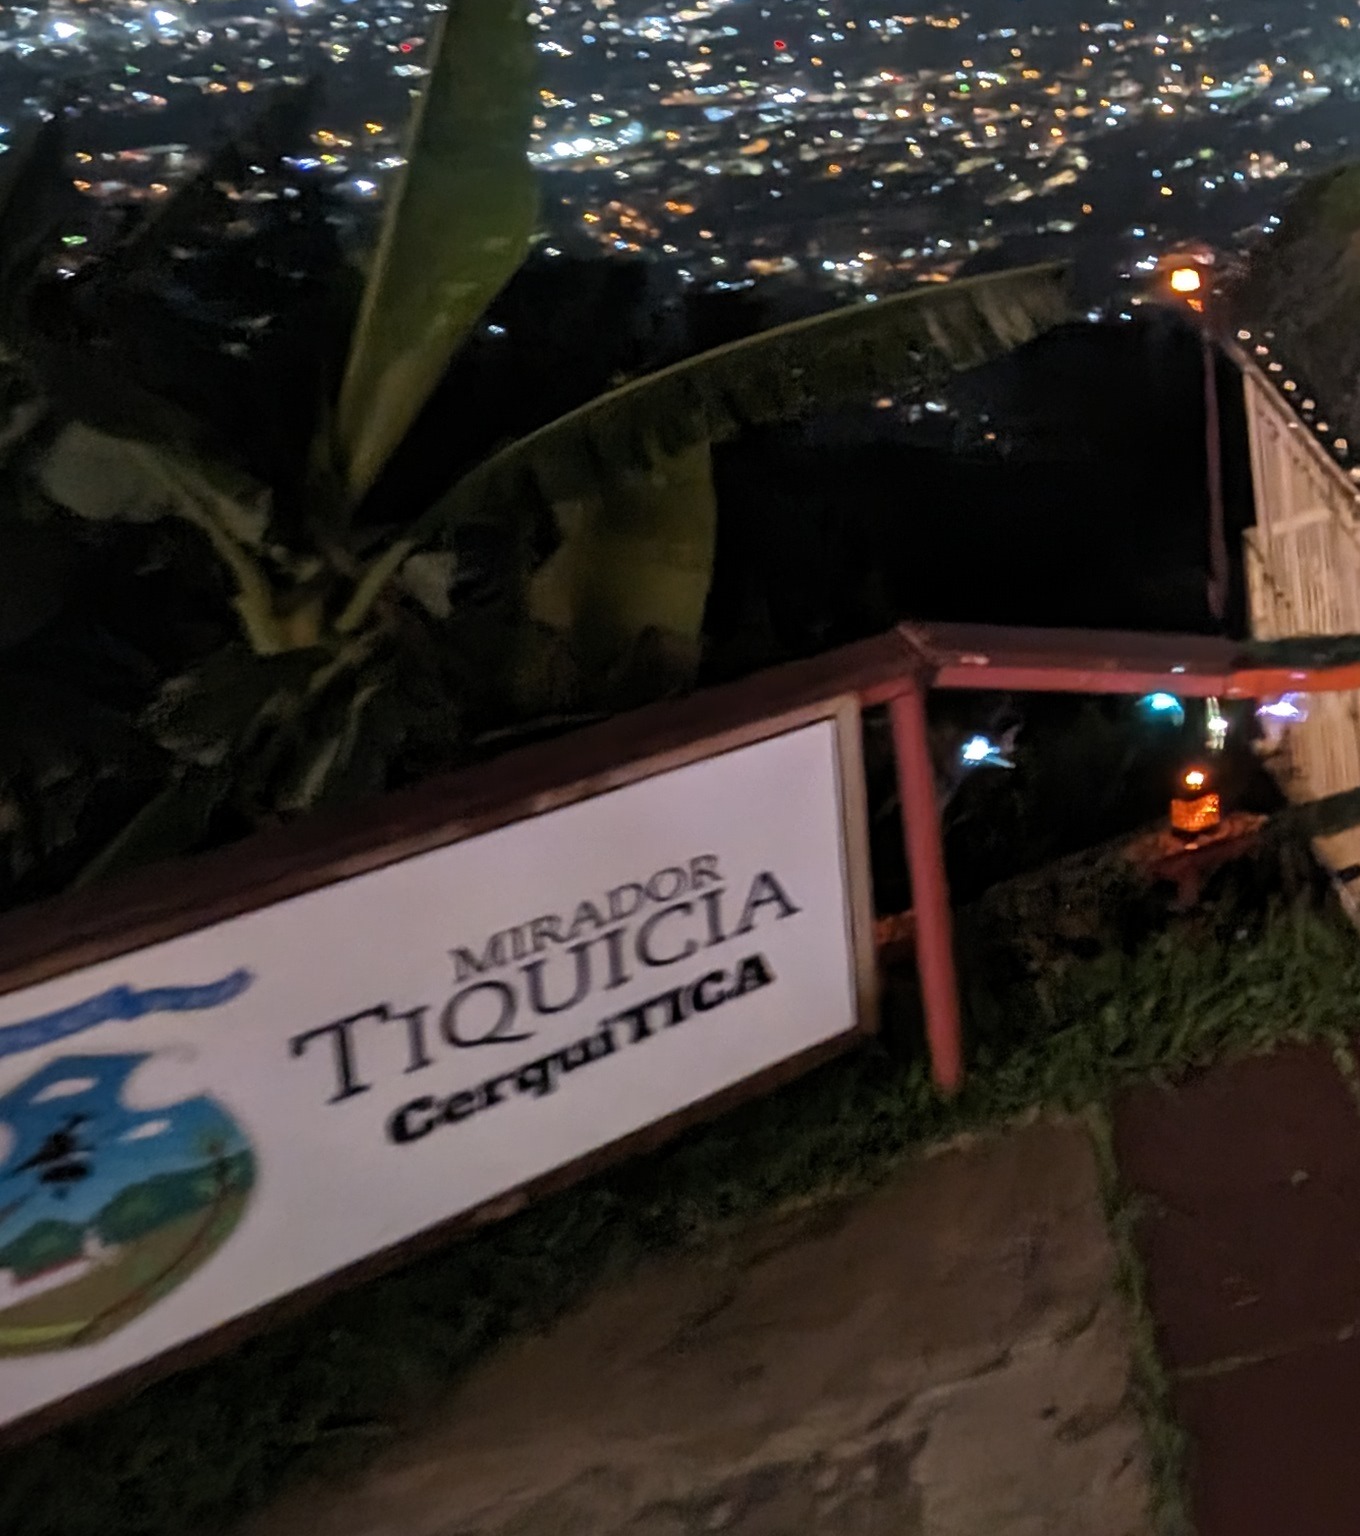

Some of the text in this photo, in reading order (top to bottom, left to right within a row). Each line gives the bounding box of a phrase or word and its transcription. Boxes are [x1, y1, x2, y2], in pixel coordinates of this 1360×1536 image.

[290, 870, 801, 1104] TIQUICIA
[450, 854, 722, 981] MIRADOR
[388, 954, 775, 1144] CerquiTICA
